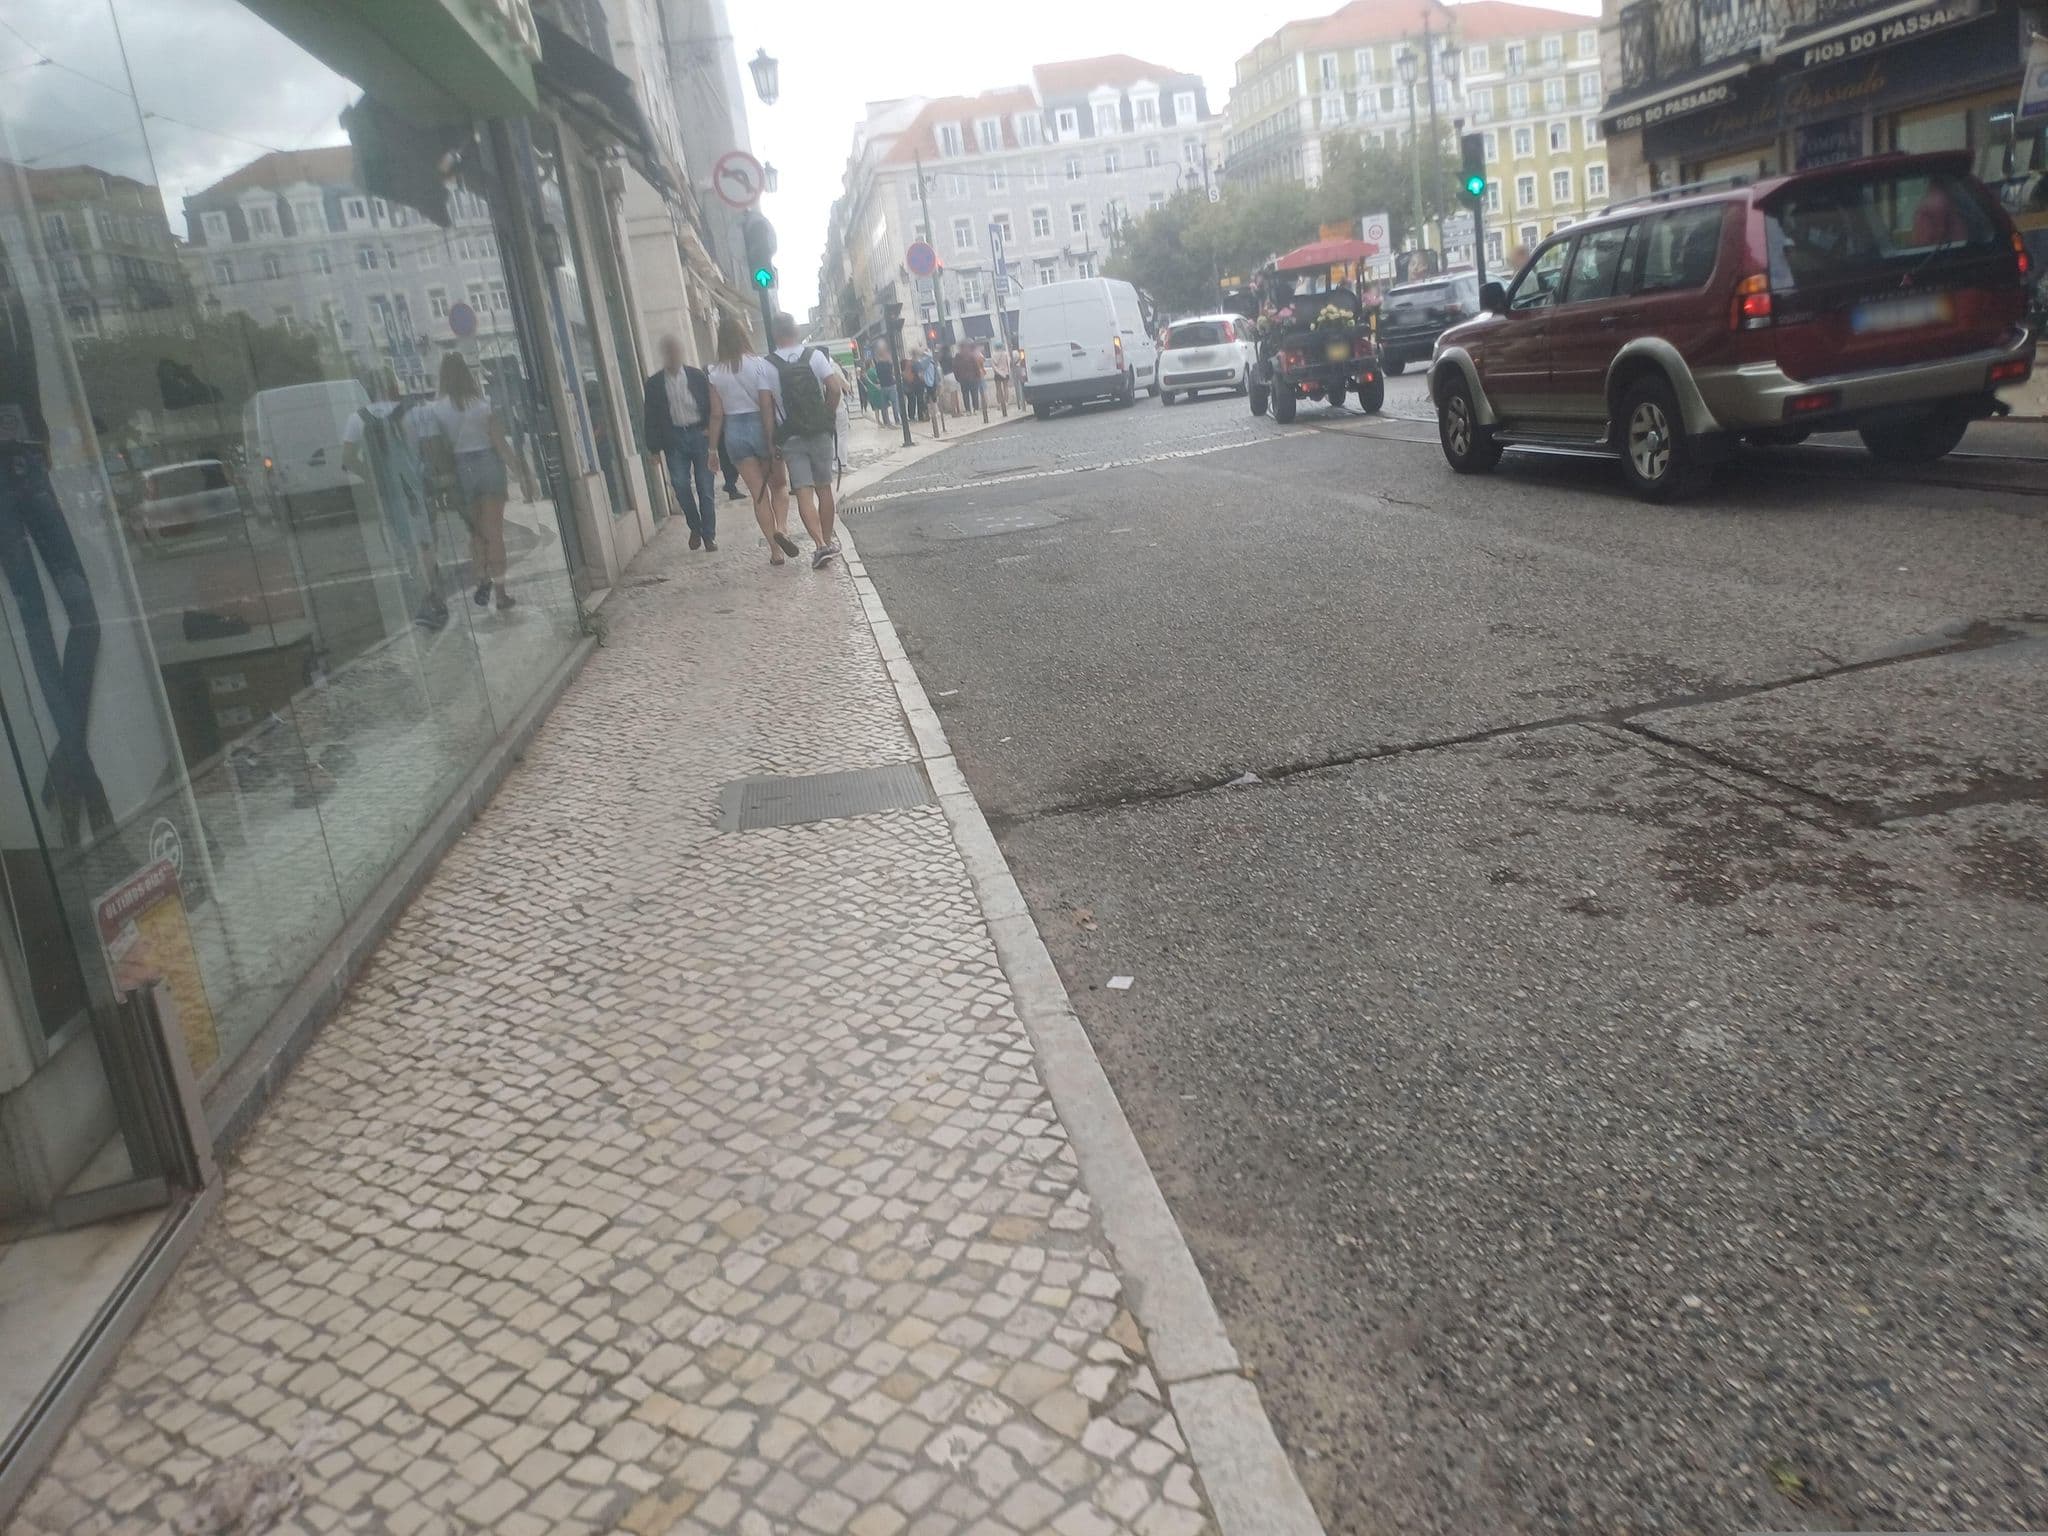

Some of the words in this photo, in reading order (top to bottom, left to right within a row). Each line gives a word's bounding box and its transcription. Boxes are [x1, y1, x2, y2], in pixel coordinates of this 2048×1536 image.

[1804, 42, 1845, 67] FIOS
[1850, 30, 1876, 52] DO
[1644, 106, 1663, 123] DO
[1664, 86, 1728, 116] PASSADO
